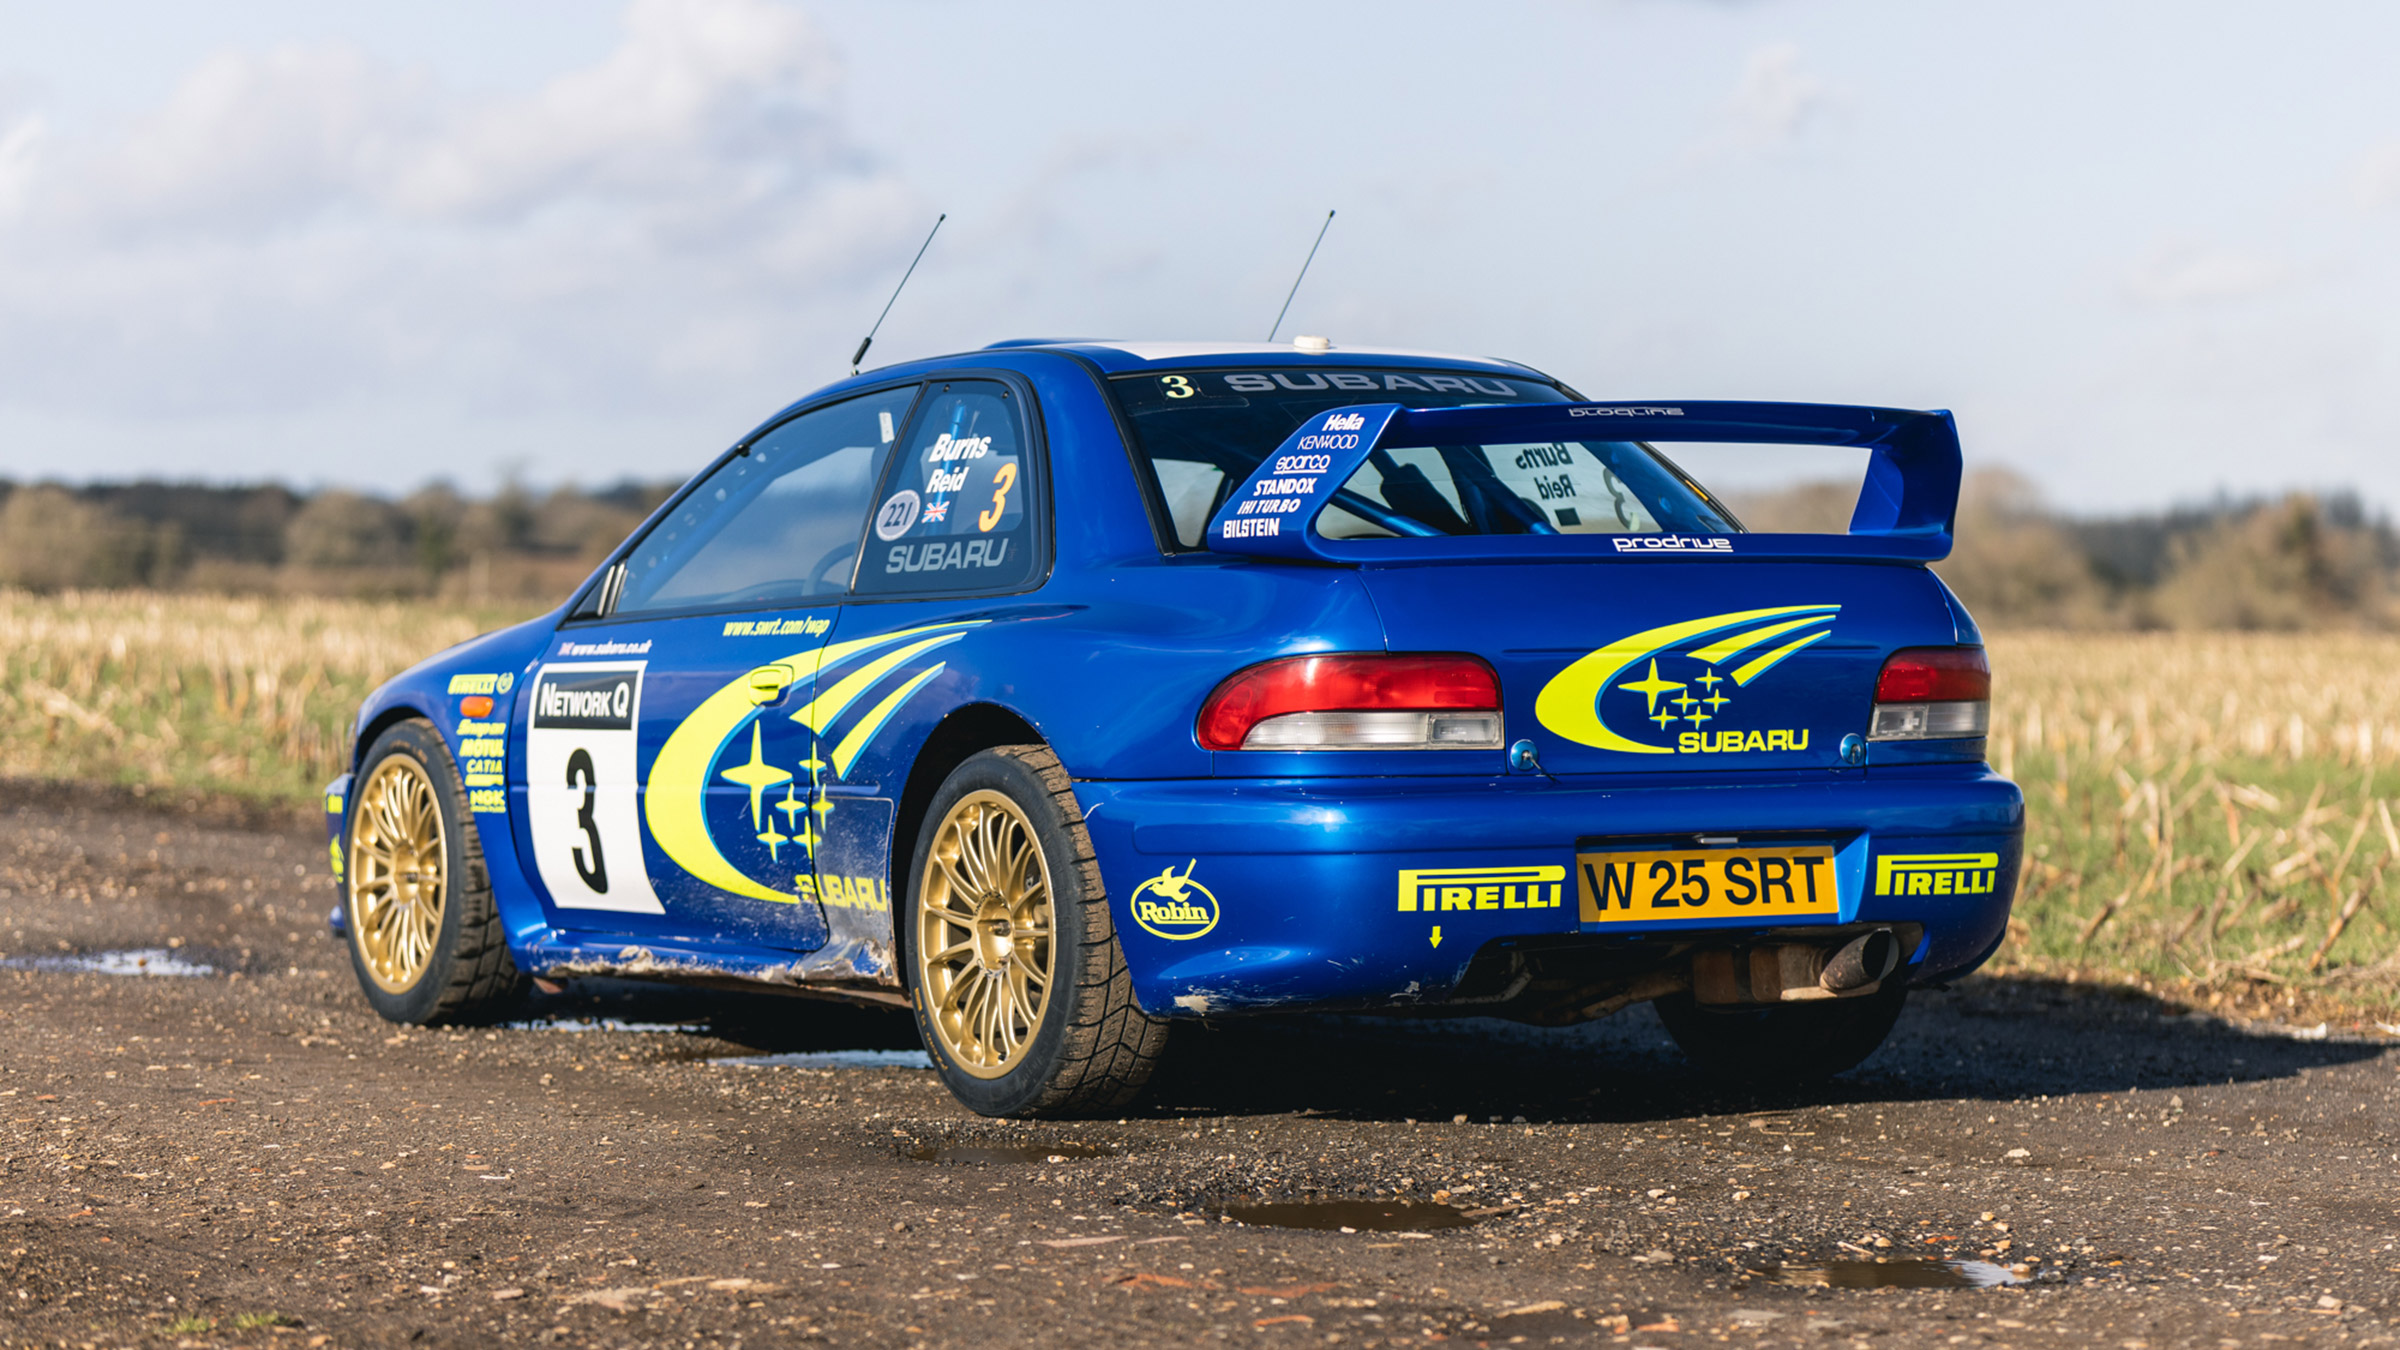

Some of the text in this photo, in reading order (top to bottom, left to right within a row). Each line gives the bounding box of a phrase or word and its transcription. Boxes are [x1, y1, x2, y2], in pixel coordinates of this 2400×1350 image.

[1161, 375, 1195, 399] 3
[1223, 373, 1517, 396] SUBARU
[1322, 413, 1365, 432] Hella
[928, 433, 992, 463] Burns
[1297, 434, 1359, 450] KENWOOD
[1273, 454, 1331, 475] sparco
[925, 466, 970, 494] Reid
[1253, 477, 1318, 496] STANDOX
[978, 462, 1017, 532] 3
[1237, 498, 1301, 515] IHI TURBO
[883, 502, 913, 528] 221
[1223, 518, 1280, 538] BILSTEIN
[885, 538, 1009, 573] SUBARU
[1612, 534, 1734, 553] prodrive
[722, 615, 830, 638] www.swrt.com/wap
[613, 682, 630, 718] Q
[459, 738, 505, 757] MOTUL
[1678, 729, 1809, 753] SUBARU
[466, 758, 503, 773] CATIA
[469, 789, 505, 806] NGK
[566, 748, 609, 894] 3
[1583, 855, 1825, 911] W 25 SRT
[1875, 852, 1999, 896] PIRELLI
[794, 873, 888, 912] SUBARU
[1397, 865, 1566, 912] PIRELLI
[1138, 901, 1210, 925] Robin
